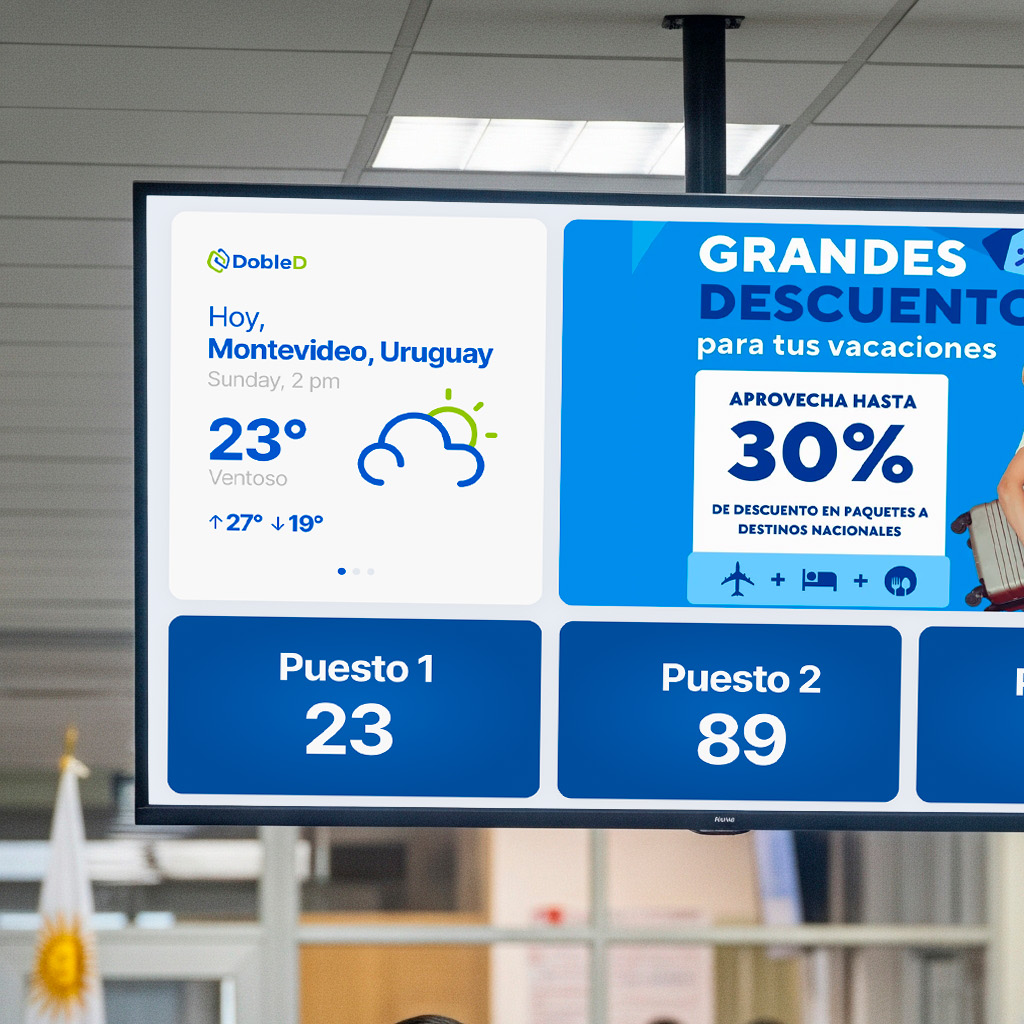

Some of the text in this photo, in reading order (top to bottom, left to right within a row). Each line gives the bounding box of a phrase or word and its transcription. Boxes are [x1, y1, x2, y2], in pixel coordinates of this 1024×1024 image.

[233, 254, 307, 270] DobleD
[699, 235, 967, 278] GRANDES
[210, 306, 265, 332] Hoy,
[209, 336, 494, 369] Montevideo, Uruguay
[697, 334, 997, 360] para tus vacaciones
[208, 371, 340, 393] Sunday, 2 pm
[729, 392, 917, 410] APROVECHA HASTA
[209, 417, 307, 462] 23°
[728, 420, 914, 484] 30%
[209, 469, 288, 488] Ventoso
[712, 503, 929, 520] DE DESCUENTO EN PAQUETES A
[738, 524, 902, 538] DESTINOS NACIONALES
[279, 653, 433, 683] Puesto 1
[662, 663, 822, 694] Puesto 2
[305, 702, 394, 756] 23
[697, 713, 787, 767] 89
